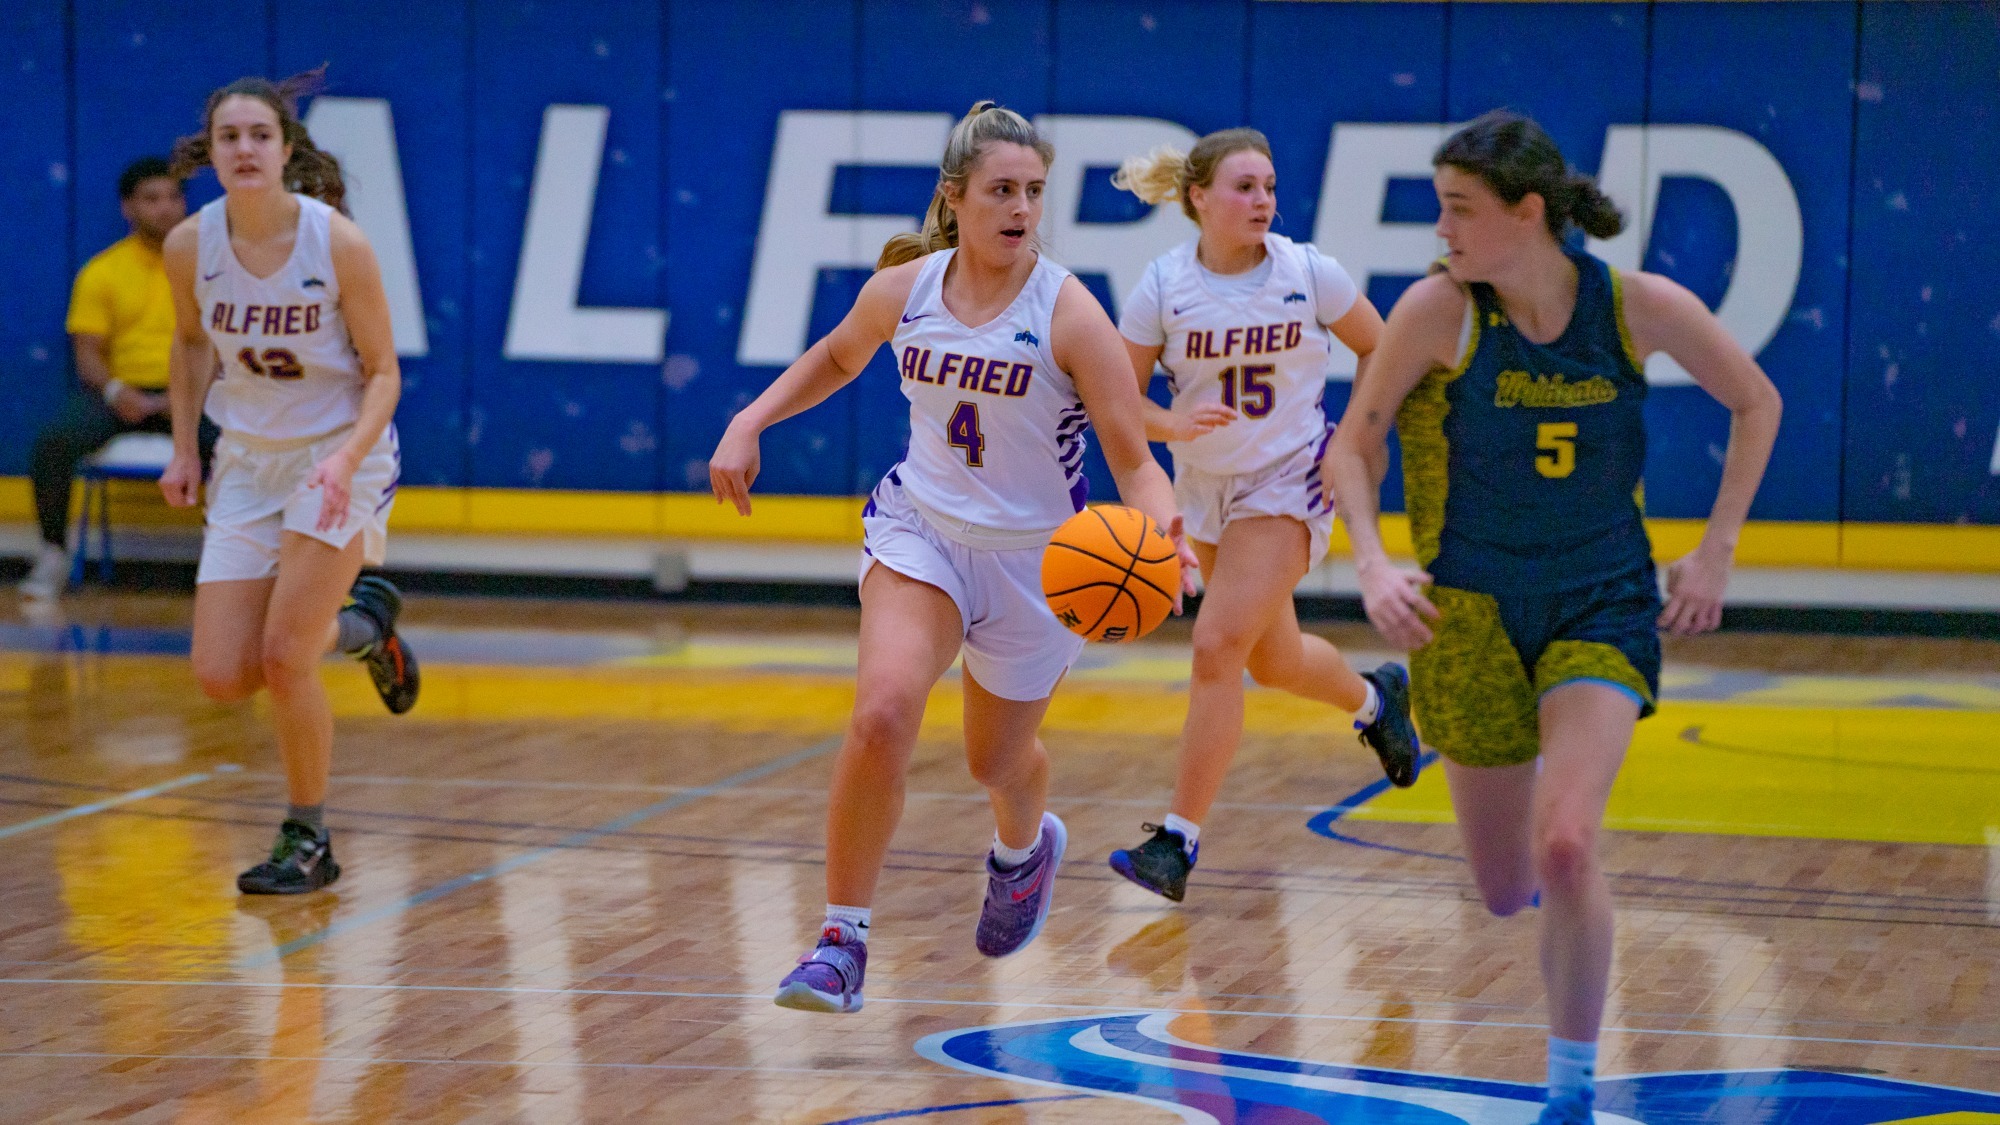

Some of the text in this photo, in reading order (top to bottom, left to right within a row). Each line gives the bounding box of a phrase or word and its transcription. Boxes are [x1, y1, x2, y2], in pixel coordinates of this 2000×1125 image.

[211, 302, 321, 336] ALFRED
[1185, 321, 1303, 360] ALFRED
[237, 347, 306, 382] 12
[901, 346, 1034, 397] ALFRED
[1217, 363, 1277, 421] 15
[946, 400, 985, 468] 4
[1534, 420, 1579, 479] 5
